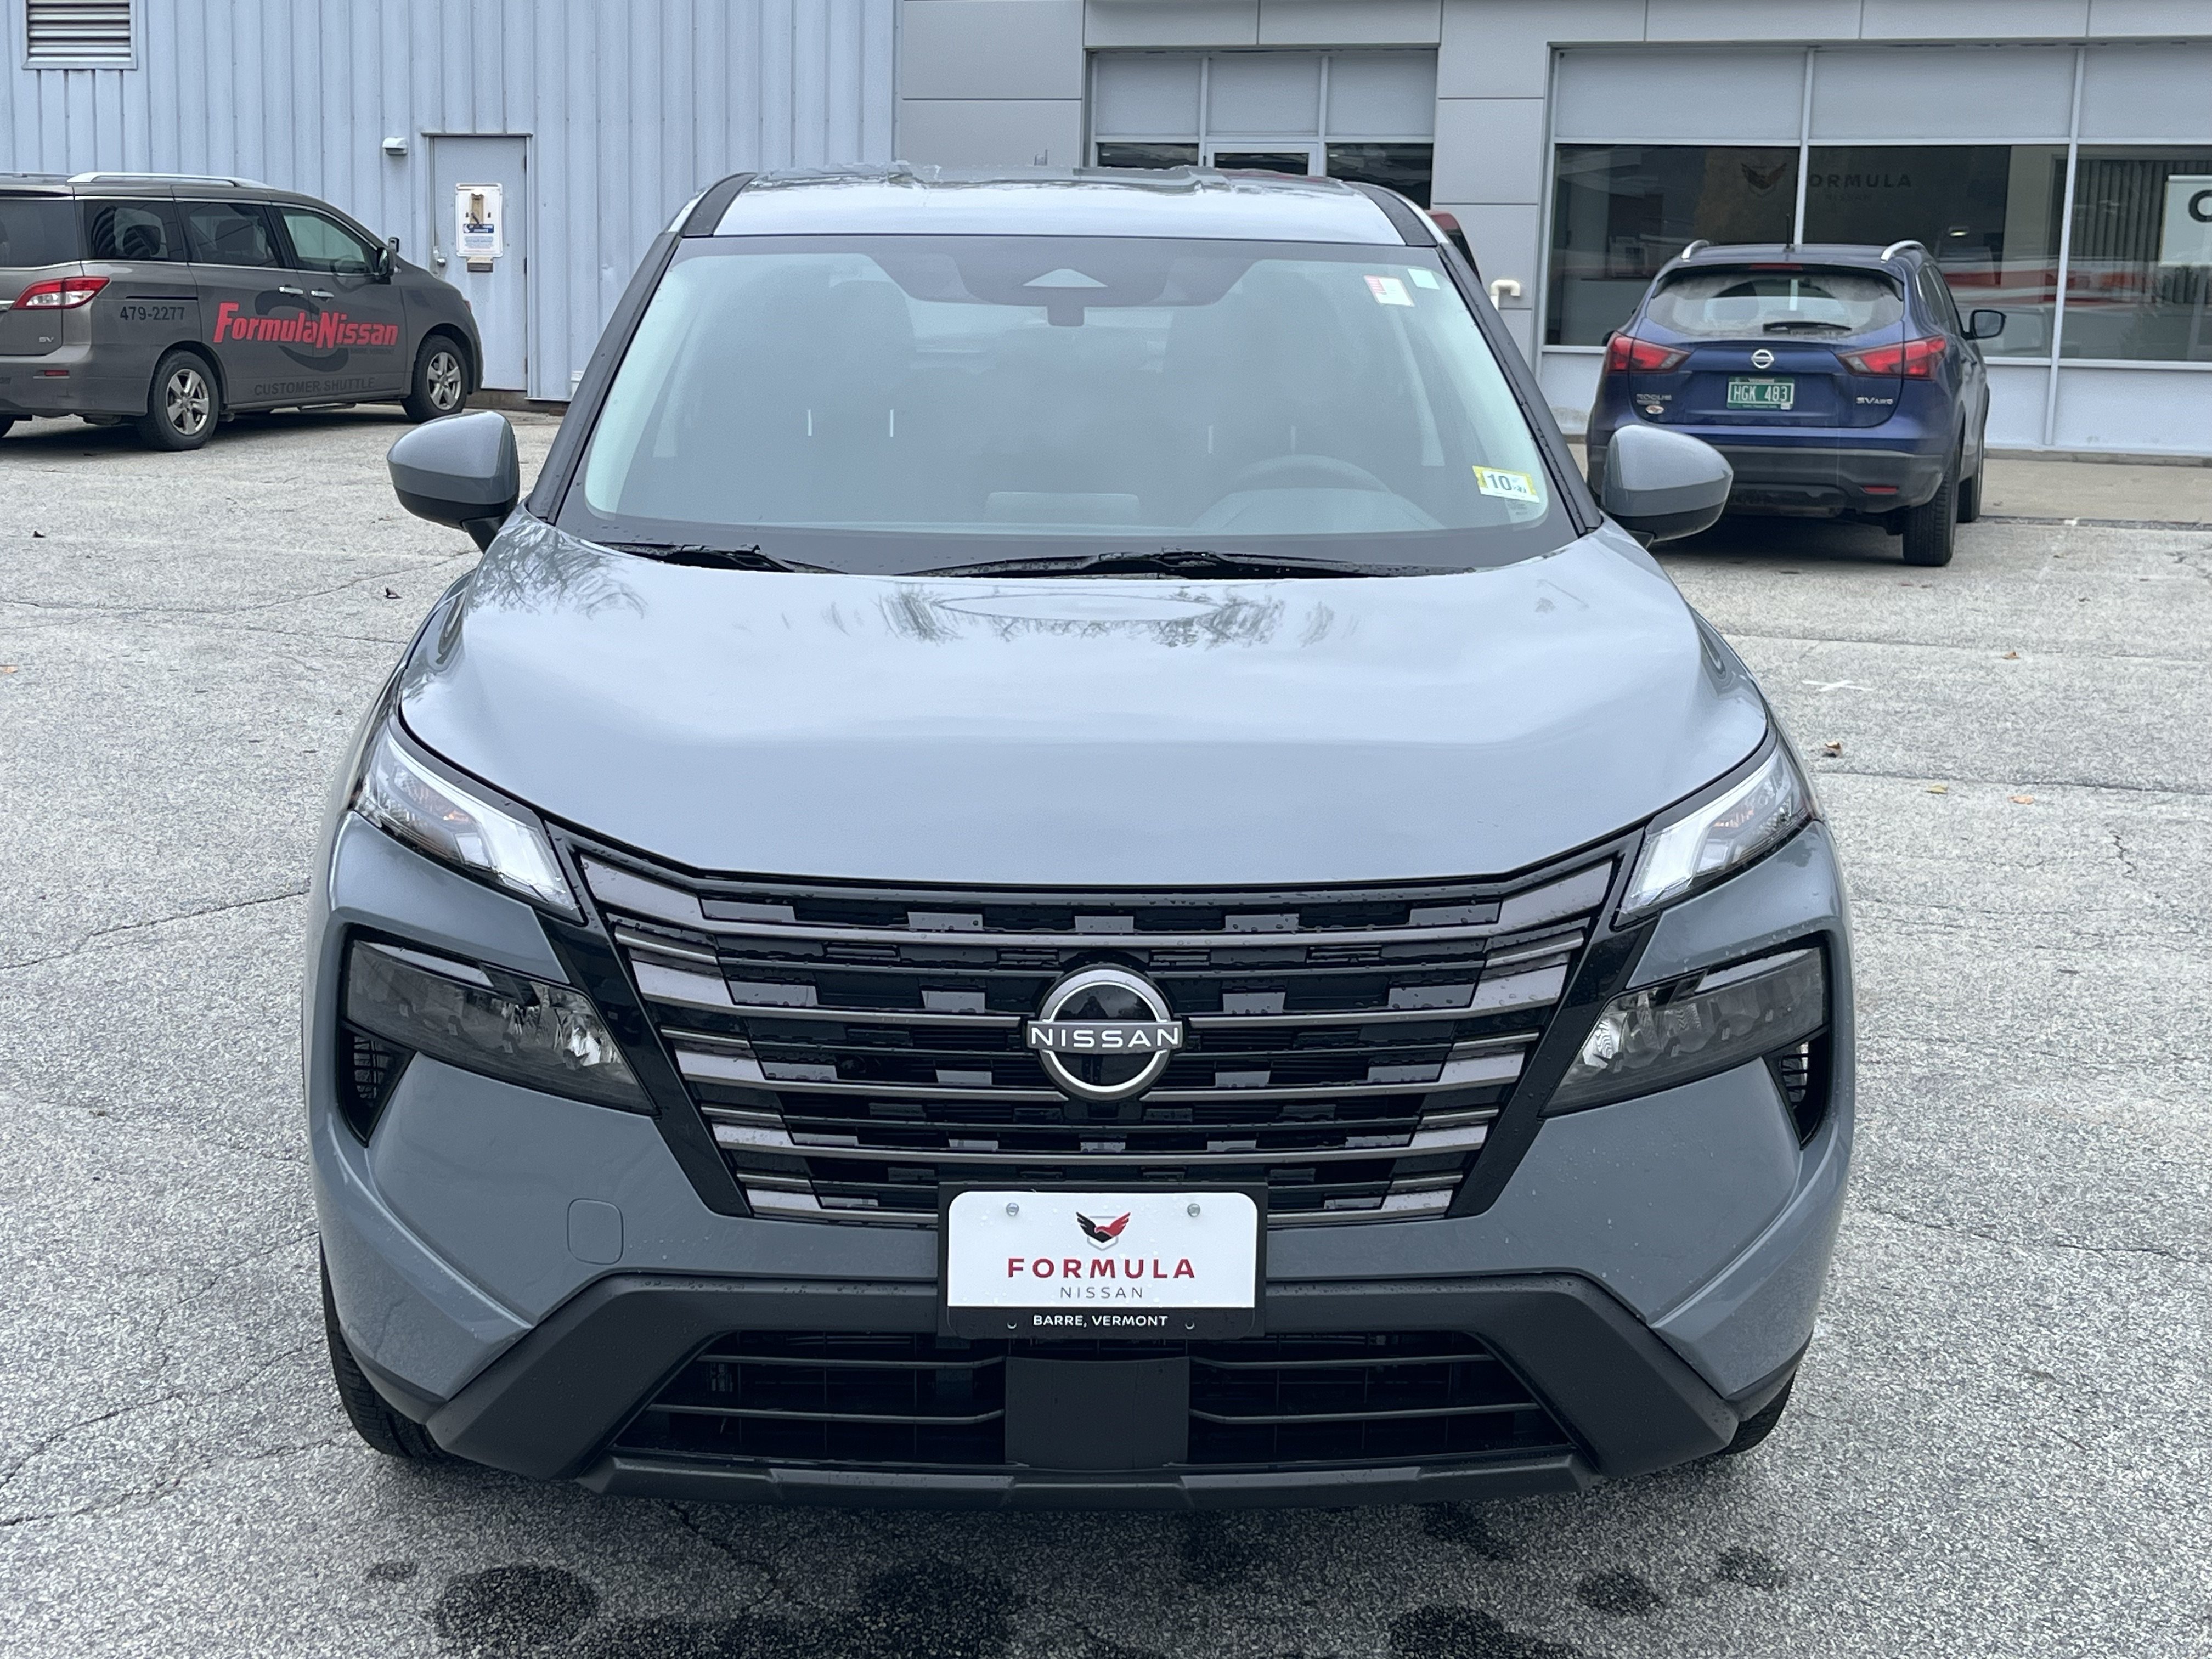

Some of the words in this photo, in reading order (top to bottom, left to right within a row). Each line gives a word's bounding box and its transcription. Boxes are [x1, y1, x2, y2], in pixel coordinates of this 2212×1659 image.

[1808, 174, 1912, 188] ORMULA
[120, 306, 185, 321] 479-2277
[253, 380, 321, 396] CUSTOMER
[324, 377, 375, 392] SHUTTLE
[1733, 385, 1757, 401] HGK
[1764, 385, 1788, 402] 483
[1487, 473, 1513, 491] 10
[1031, 1027, 1178, 1048] NISSAN
[1008, 1258, 1195, 1279] FORMULA
[1060, 1286, 1143, 1299] NISSAN
[1033, 1314, 1088, 1328] BARRE,
[1091, 1315, 1169, 1327] VERMONT
